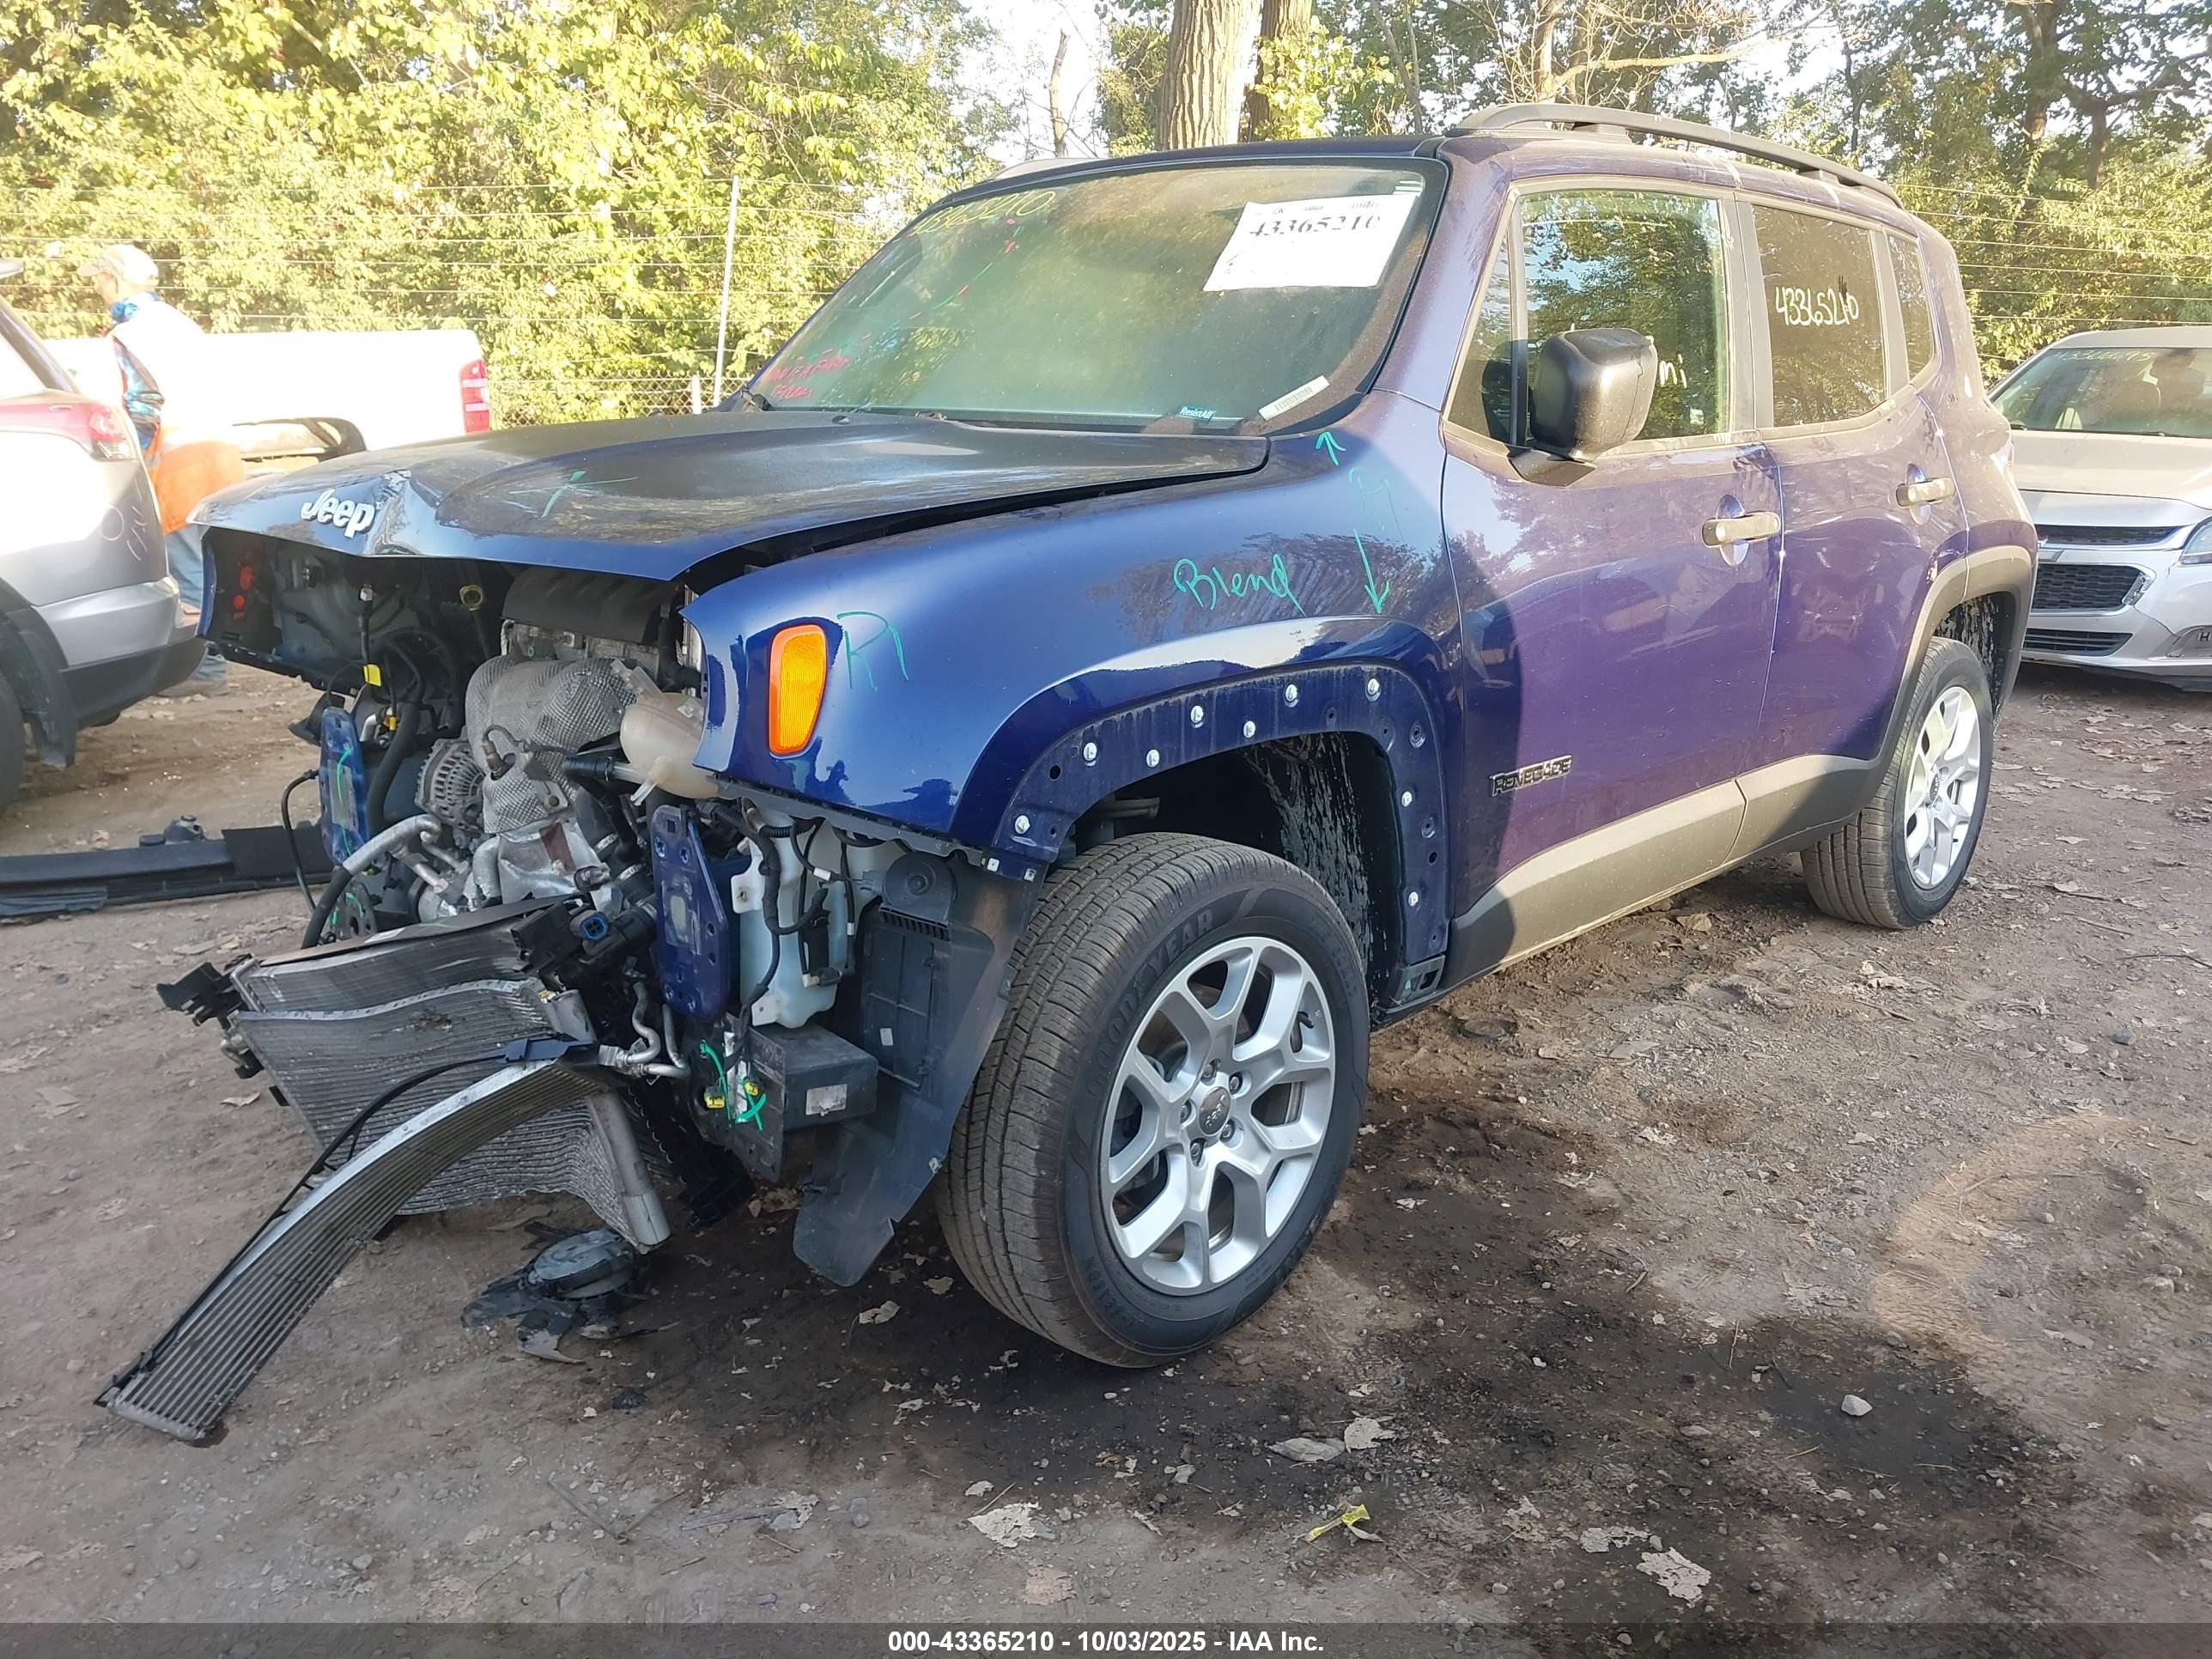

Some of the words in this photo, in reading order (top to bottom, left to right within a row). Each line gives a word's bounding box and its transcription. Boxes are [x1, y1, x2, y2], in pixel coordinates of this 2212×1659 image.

[1775, 286, 1859, 326] 43365210
[301, 488, 376, 538] Jeep
[1173, 553, 1307, 617] Blend
